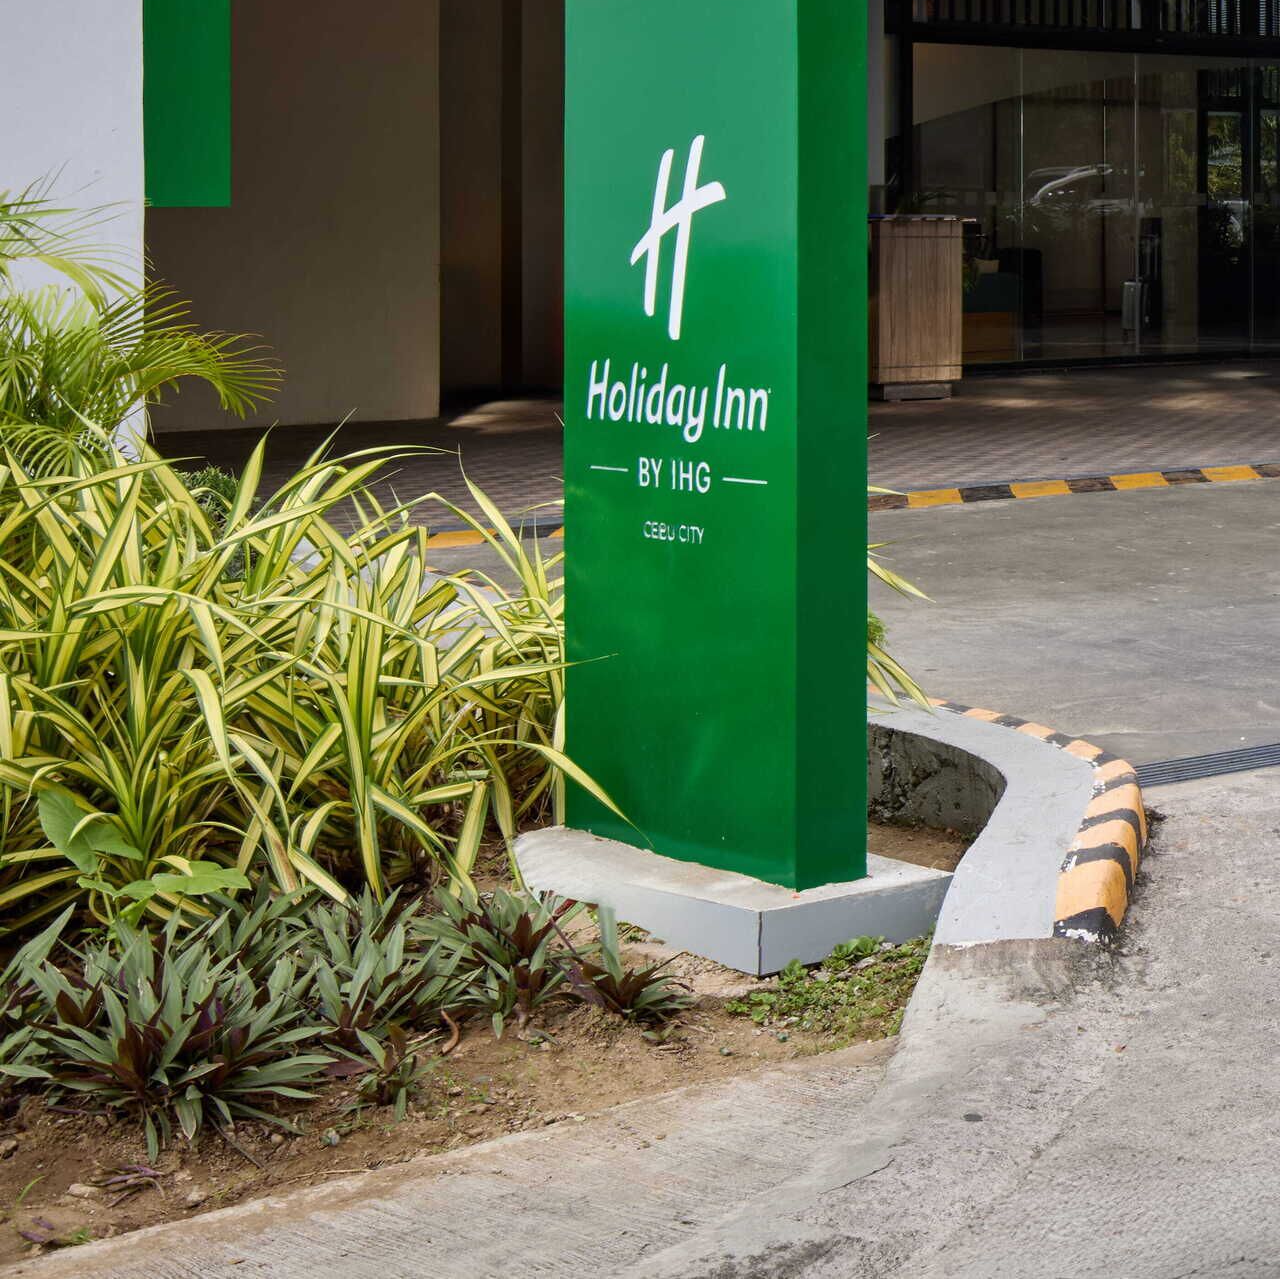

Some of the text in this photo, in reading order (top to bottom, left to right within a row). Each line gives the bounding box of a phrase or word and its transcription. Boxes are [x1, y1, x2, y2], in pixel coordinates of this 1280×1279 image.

[586, 358, 769, 443] Holiday Inn
[638, 457, 711, 494] BY IHG
[643, 520, 705, 545] CEBU CITY
